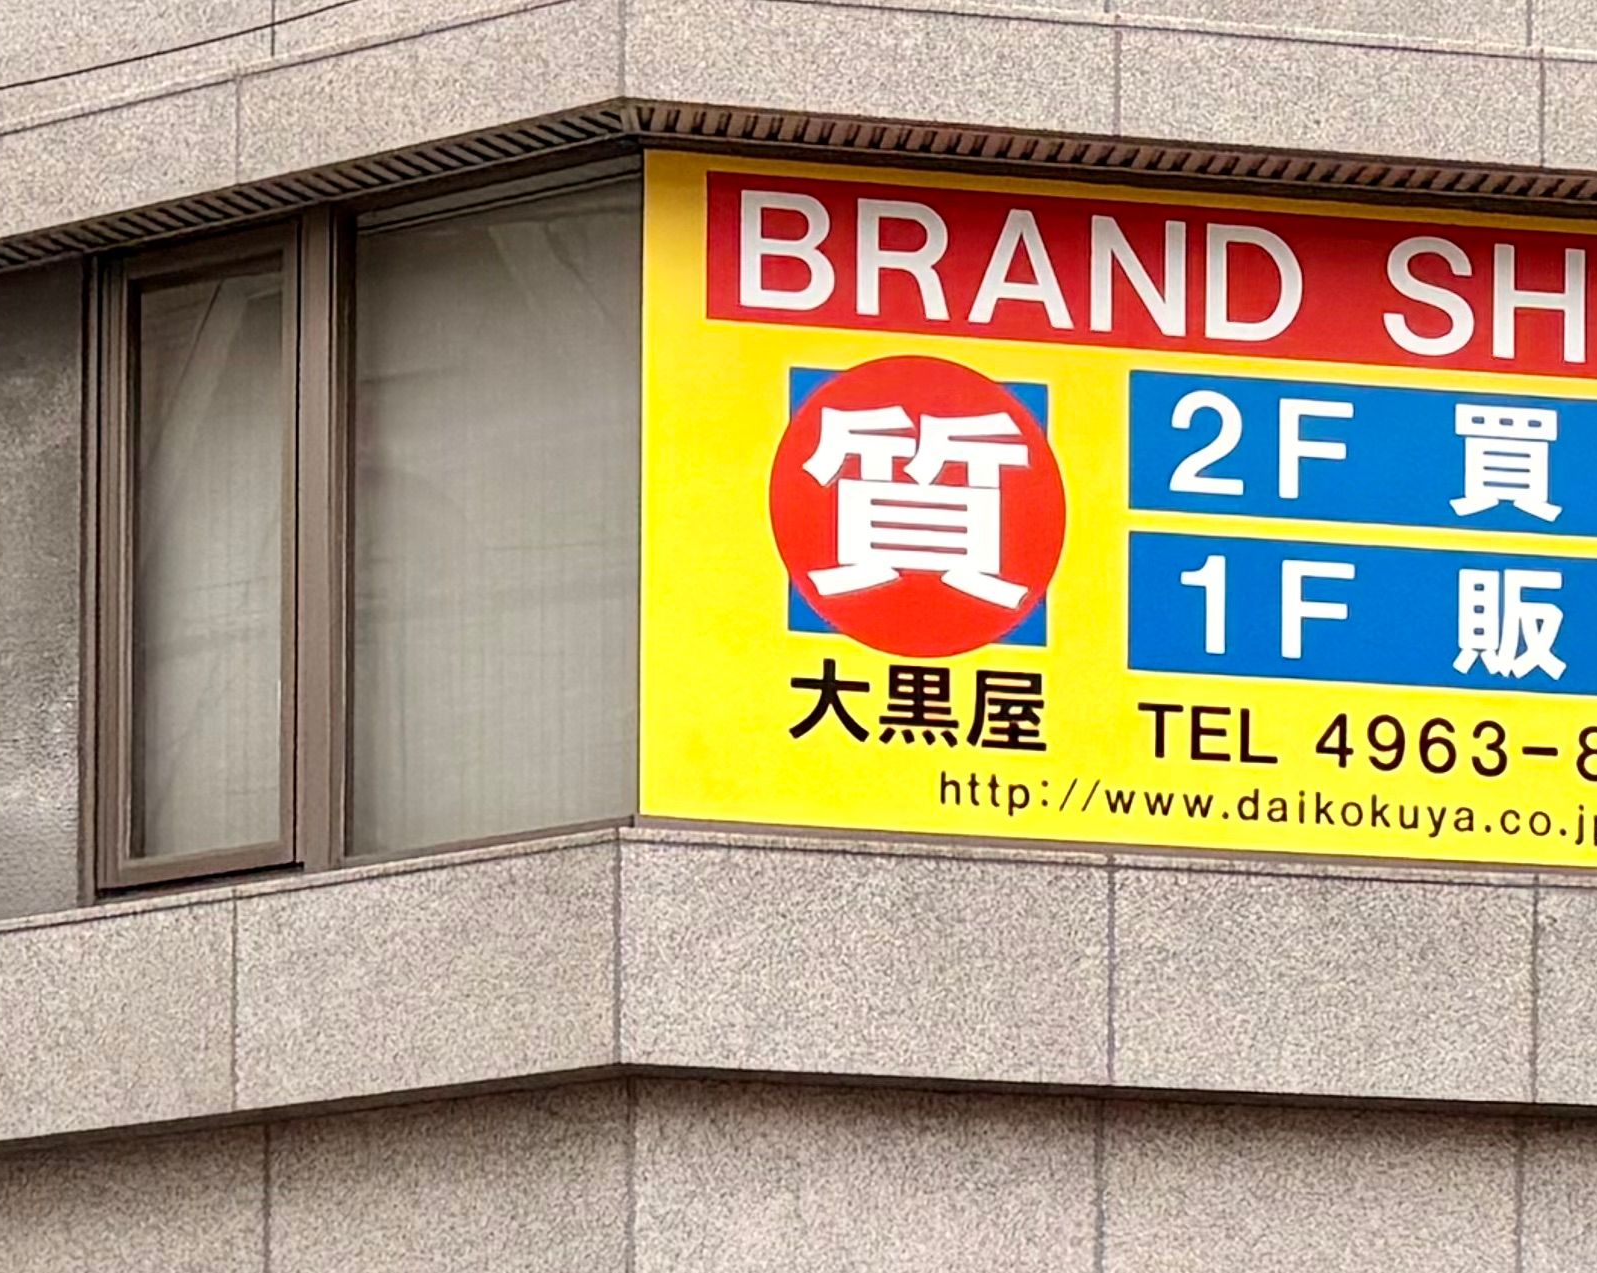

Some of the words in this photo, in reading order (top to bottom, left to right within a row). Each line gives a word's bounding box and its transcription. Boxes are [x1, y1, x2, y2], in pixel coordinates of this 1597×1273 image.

[739, 189, 1303, 342] BRAND
[1169, 389, 1354, 500] 2F
[803, 405, 1029, 610] 質
[1179, 554, 1355, 659] 1F
[789, 658, 1047, 751] 大黒屋
[1137, 702, 1278, 765] TEL
